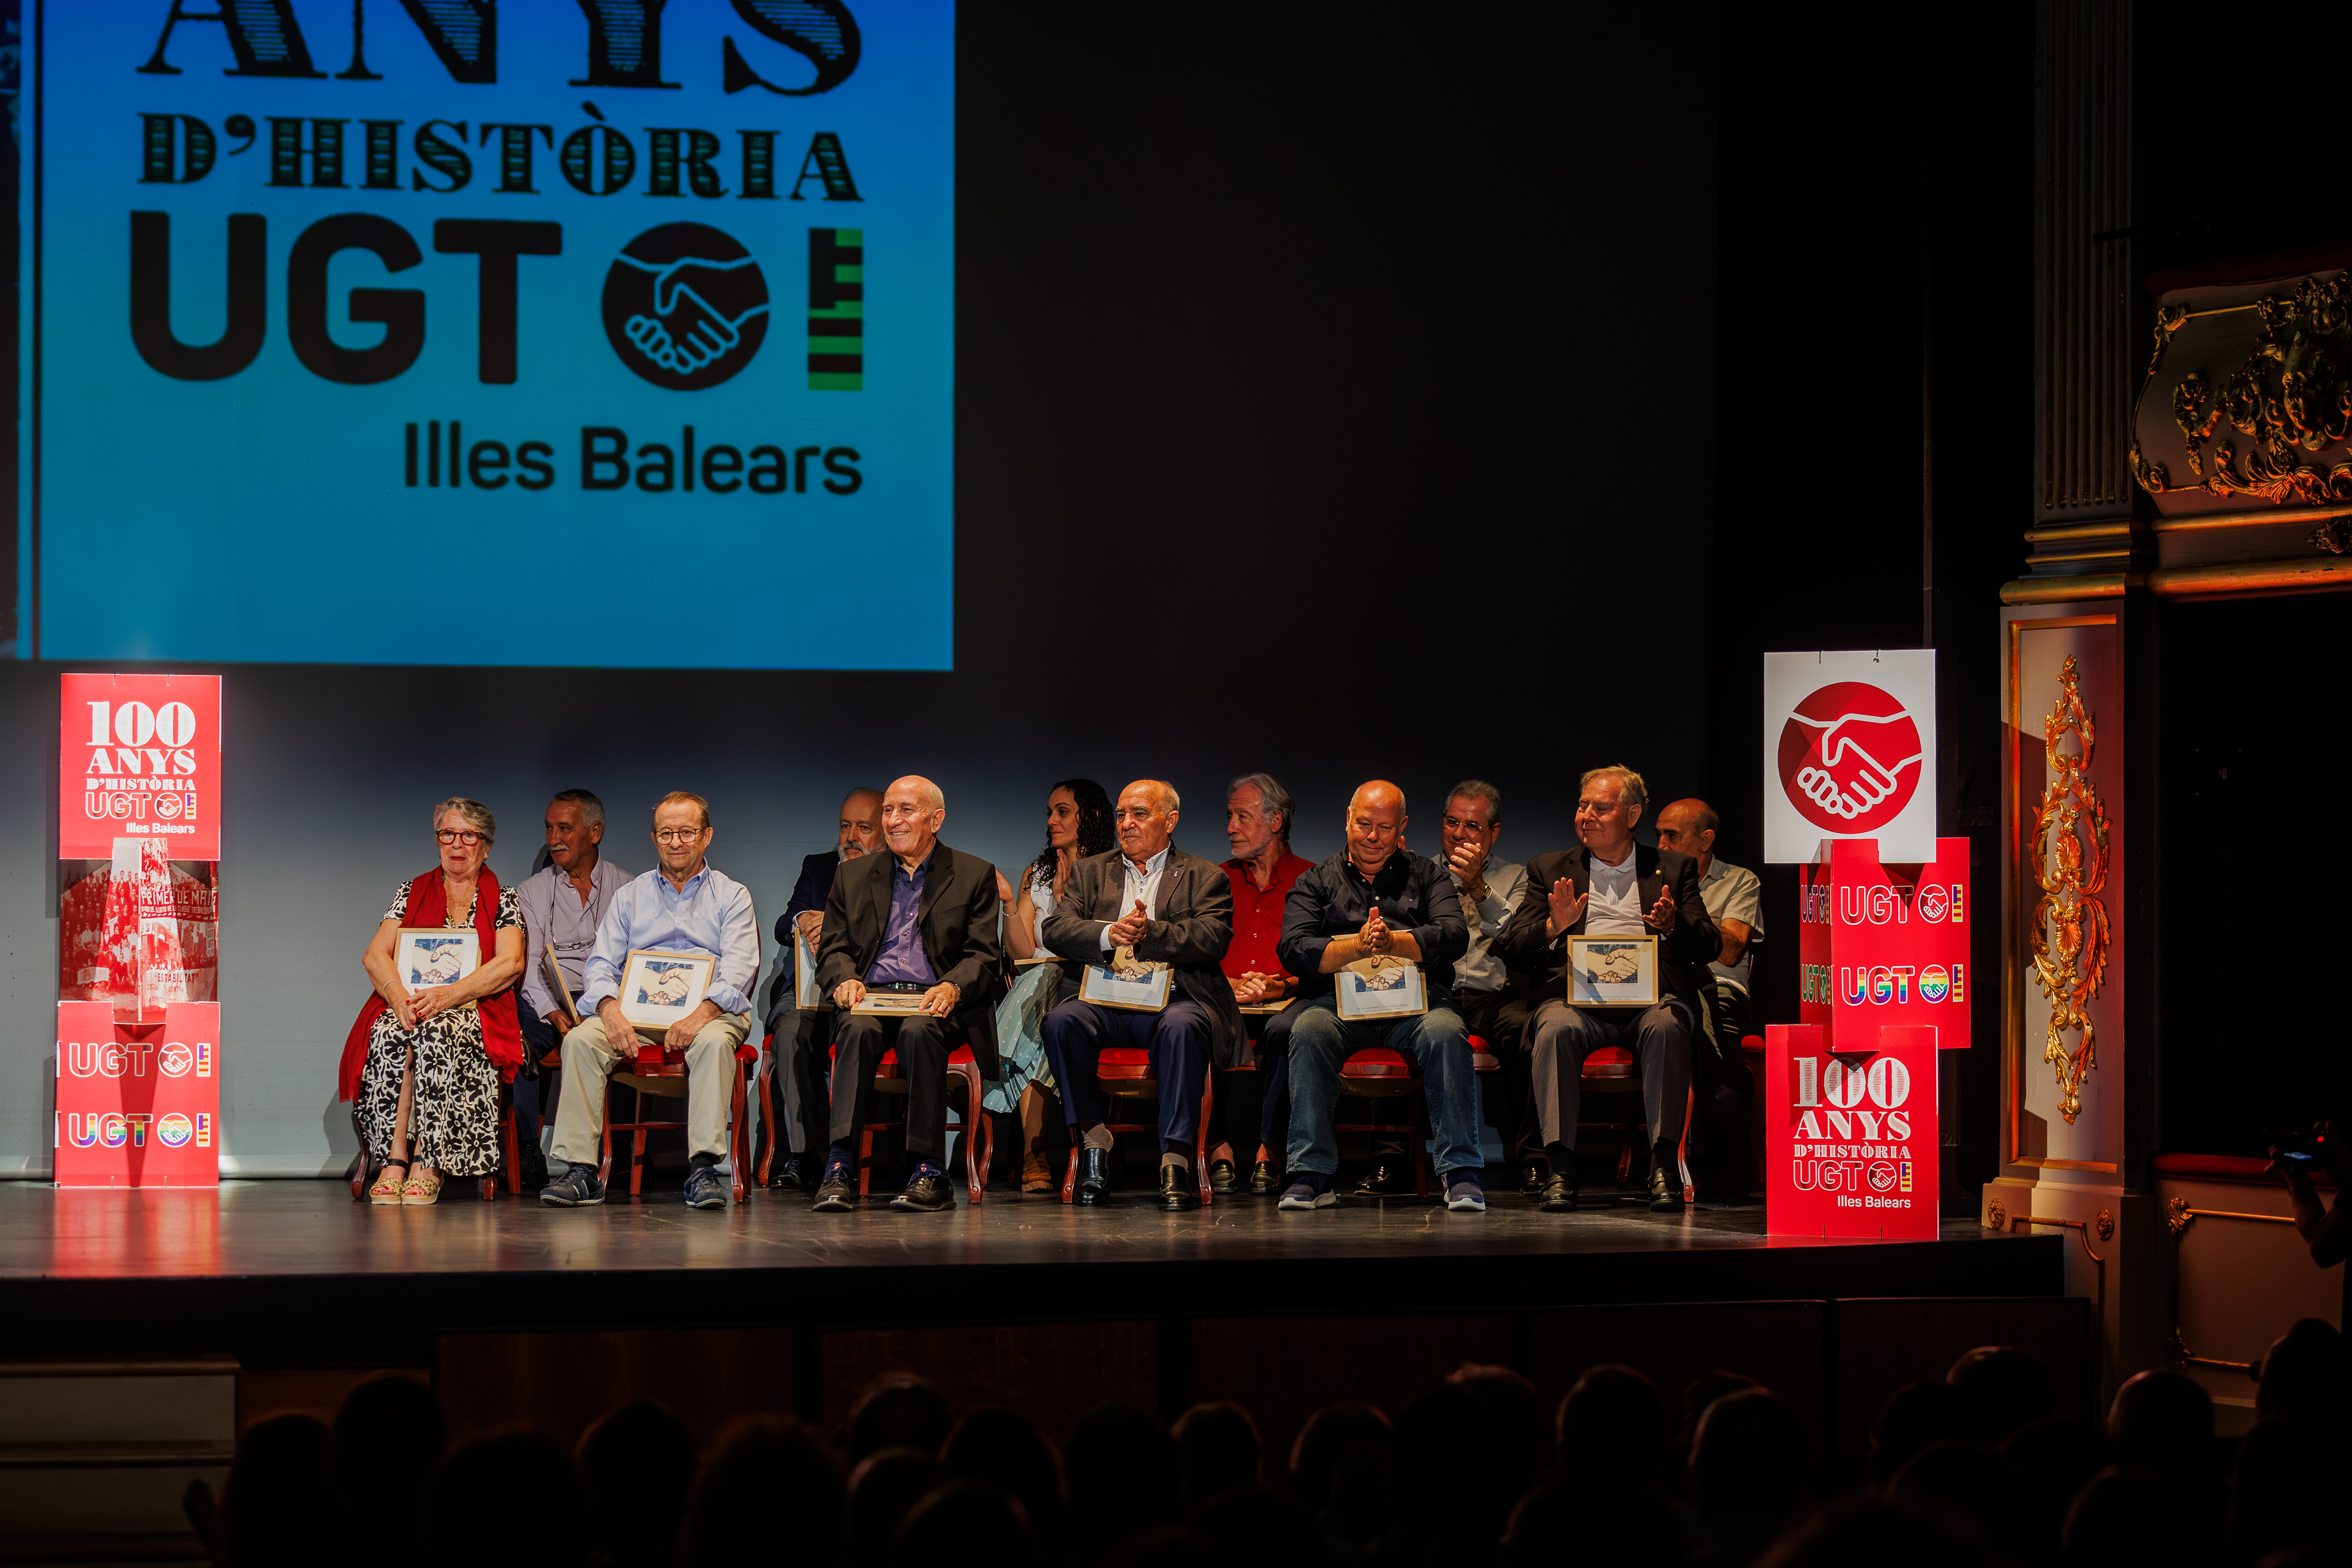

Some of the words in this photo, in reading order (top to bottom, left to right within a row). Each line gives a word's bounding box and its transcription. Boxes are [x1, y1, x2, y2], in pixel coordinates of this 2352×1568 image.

[129, 210, 562, 385] UGT
[405, 420, 554, 491] Illes
[581, 425, 862, 496] Balears
[86, 701, 196, 747] 100
[86, 748, 196, 775] ANYS
[86, 791, 152, 820] UGT
[126, 823, 150, 834] Illes
[152, 823, 195, 834] Balears
[177, 891, 189, 905] DE
[1801, 884, 1818, 923] UGT
[1840, 884, 1914, 925] UGT
[1801, 963, 1819, 1003] UGT
[1841, 965, 1915, 1006] UGT
[69, 1042, 153, 1078] UGT
[1793, 1057, 1910, 1109] 100
[69, 1112, 153, 1148] UGT
[1793, 1110, 1911, 1141] ANYS
[1793, 1159, 1864, 1191] UGT
[1838, 1194, 1863, 1207] Illes
[1865, 1196, 1911, 1208] Balears
